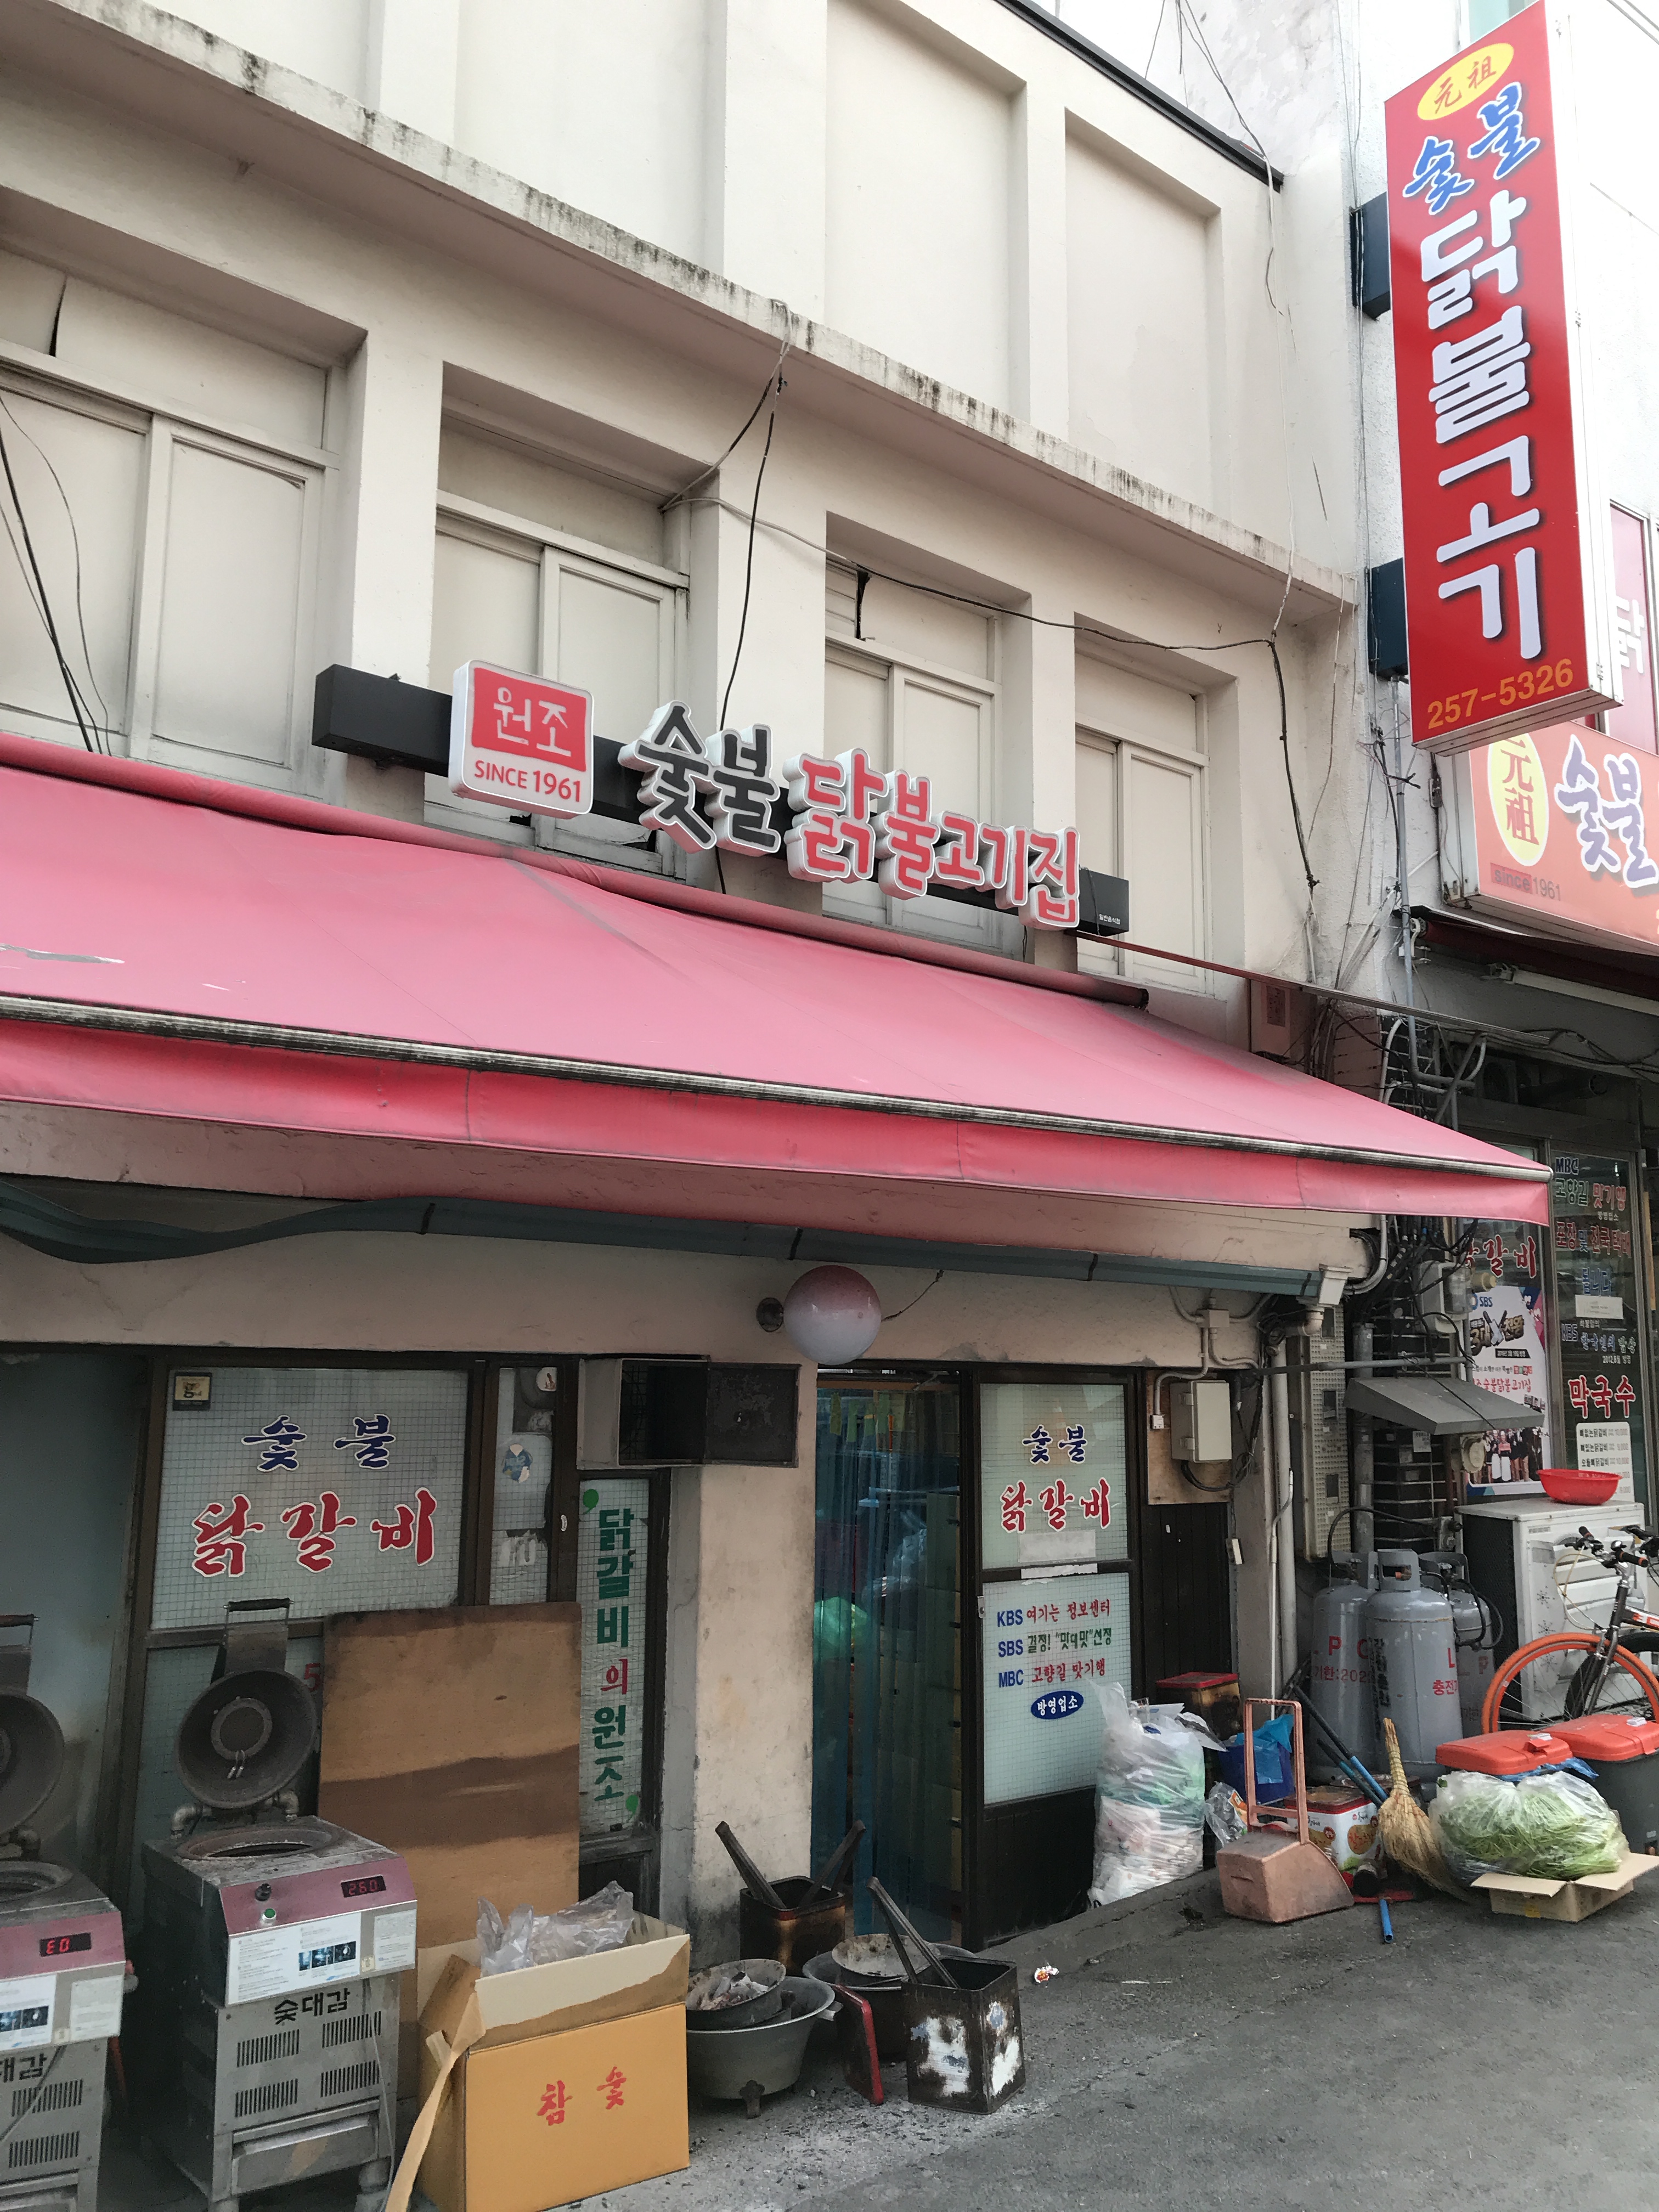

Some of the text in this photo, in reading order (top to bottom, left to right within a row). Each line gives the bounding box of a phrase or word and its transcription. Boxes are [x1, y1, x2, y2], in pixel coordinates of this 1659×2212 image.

[1434, 55, 1497, 114] 元祖
[1403, 82, 1541, 215] 숯불
[1420, 189, 1541, 659] 닭불고기
[1427, 658, 1573, 730] 257-5326
[493, 687, 572, 757] 원조
[475, 760, 582, 803] SINCE 1961
[636, 703, 1078, 924] 숯불 닭불고기집
[1494, 867, 1562, 901] since 1961
[1555, 1156, 1579, 1175] MBC
[1556, 1221, 1577, 1251] 포장
[1479, 1296, 1493, 1307] SBS
[1561, 1323, 1578, 1341] KBS
[1568, 1375, 1635, 1419] 막국수
[241, 1414, 396, 1472] 숯불
[1022, 1424, 1088, 1464] 숯불
[1000, 1477, 1111, 1534] 닭갈비
[191, 1487, 437, 1578] 닭갈비
[997, 1599, 1110, 1627] KBS 여기는 정보센터
[997, 1639, 1024, 1658] SBS
[1028, 1633, 1051, 1654] 결정!
[998, 1669, 1024, 1688] MBC
[1031, 1662, 1066, 1683] 고향길
[1037, 1695, 1079, 1717] 방영업소
[348, 1879, 379, 1896] 260
[274, 1987, 351, 2025] 숯대감
